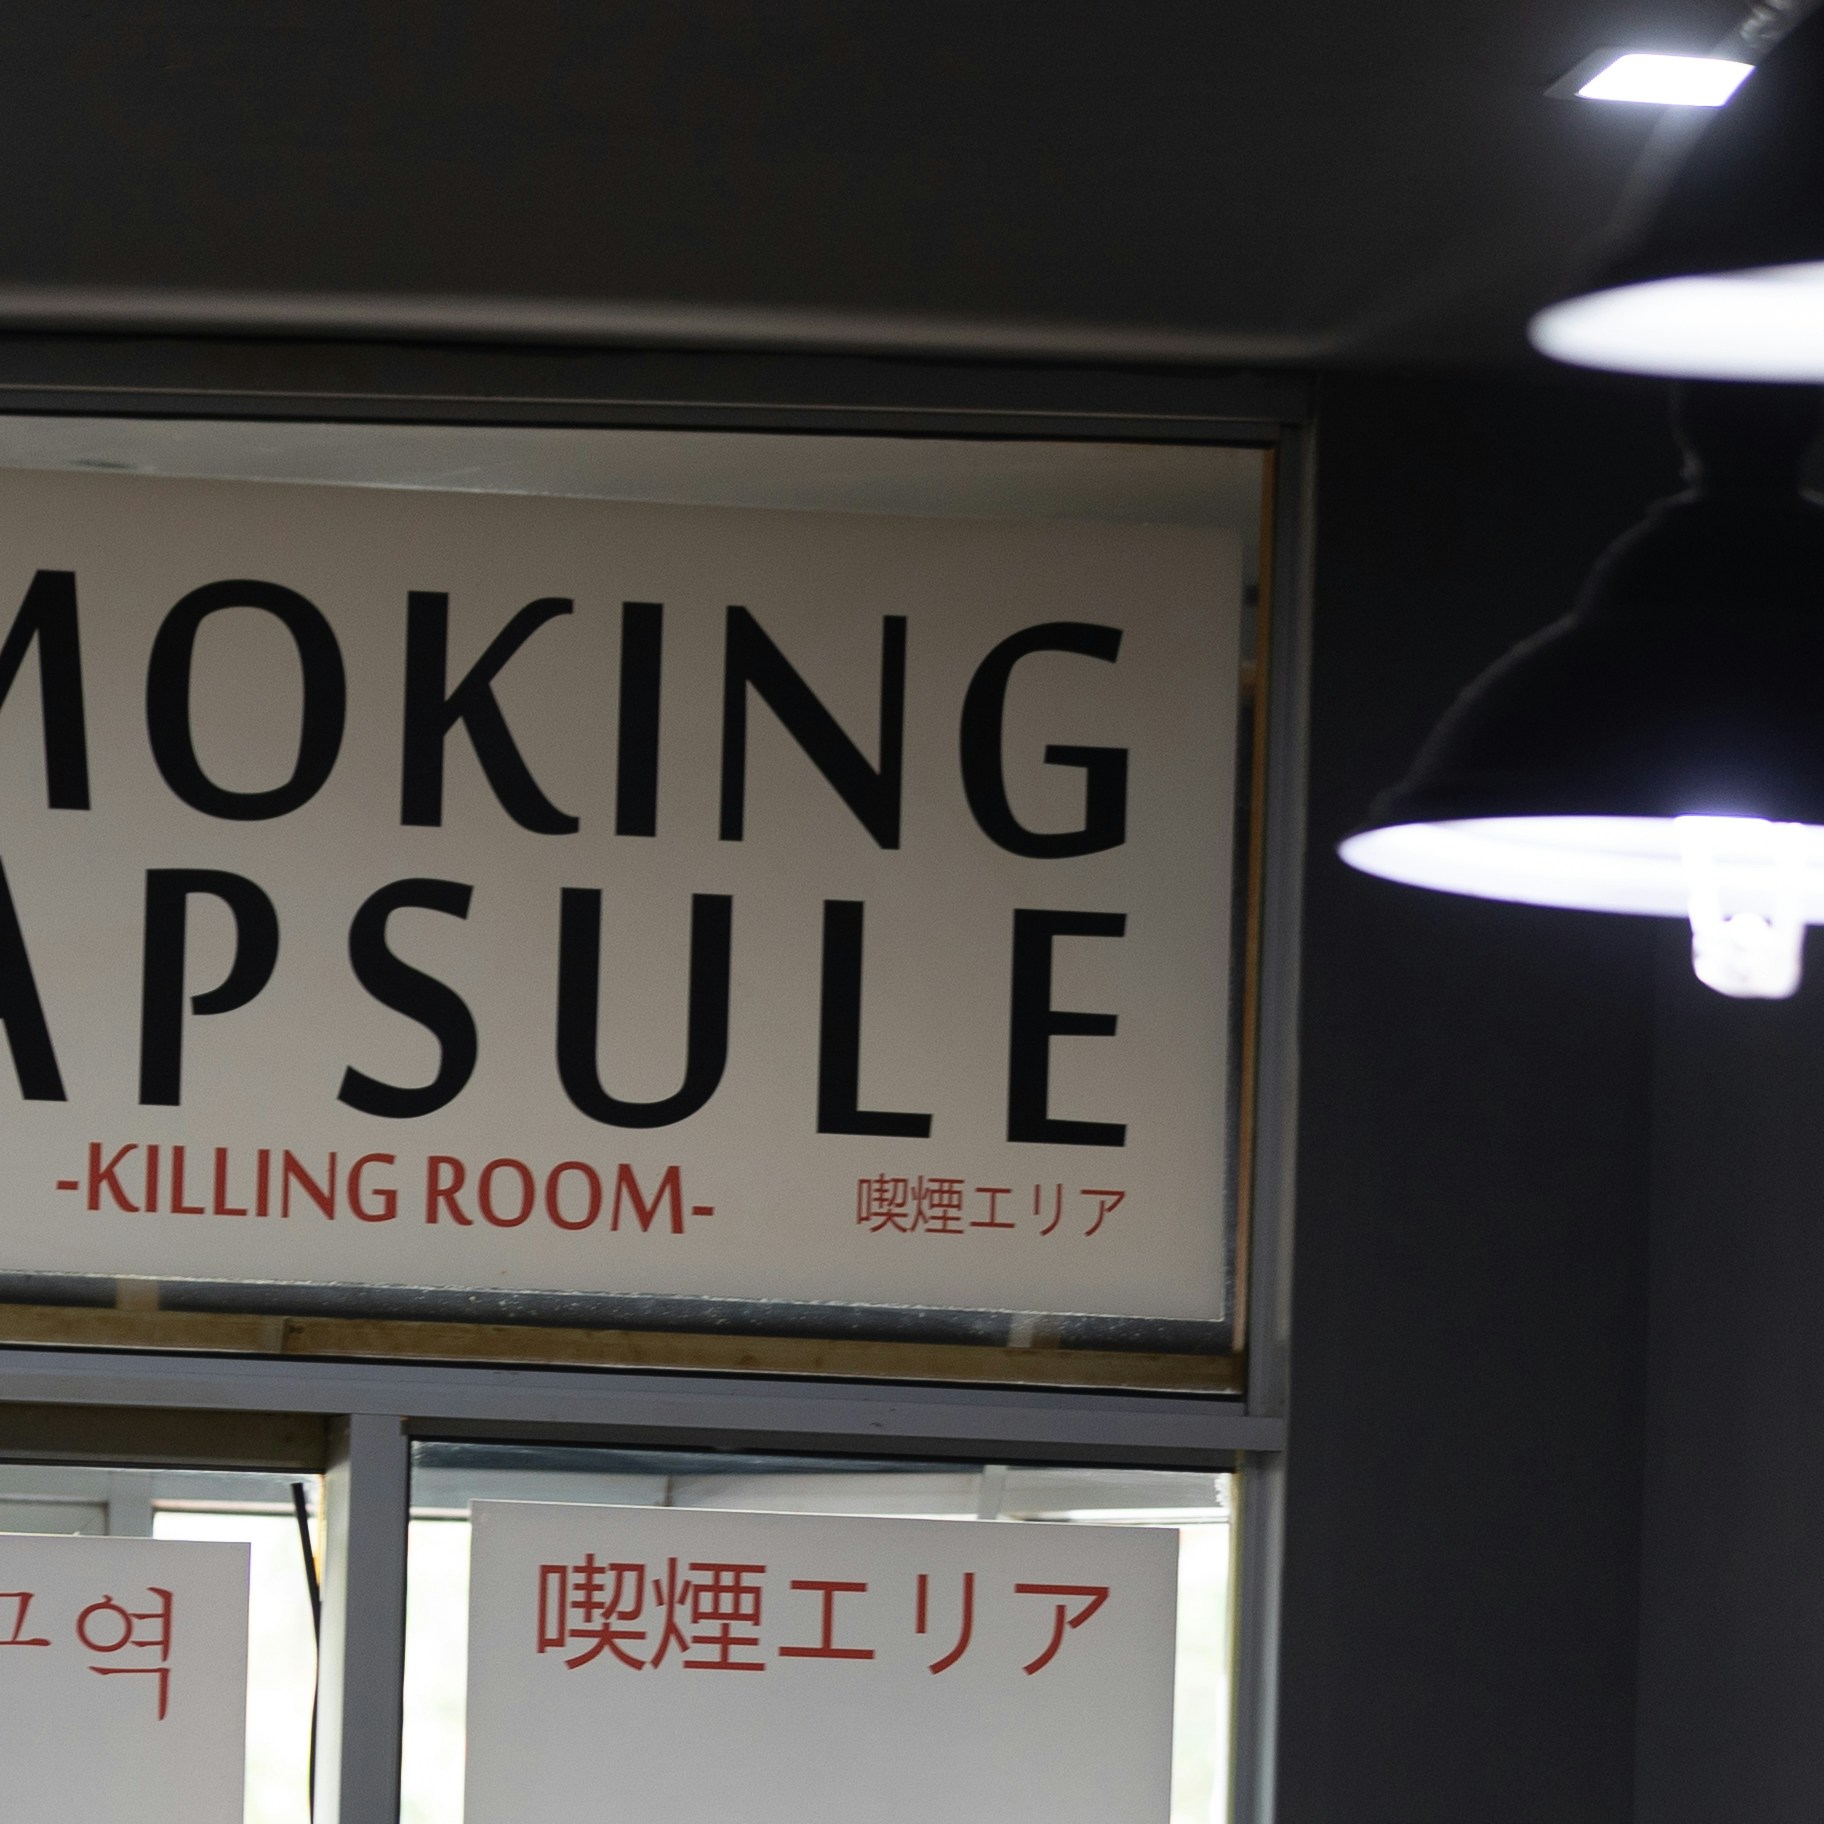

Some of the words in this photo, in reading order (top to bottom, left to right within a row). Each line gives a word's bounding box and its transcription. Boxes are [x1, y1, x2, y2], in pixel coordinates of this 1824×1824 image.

[56, 1141, 398, 1223] -KILLING
[425, 1155, 715, 1235] ROOM-
[856, 1173, 1126, 1237] 喫煙エリア
[536, 1552, 1111, 1676] 喫煙エリア
